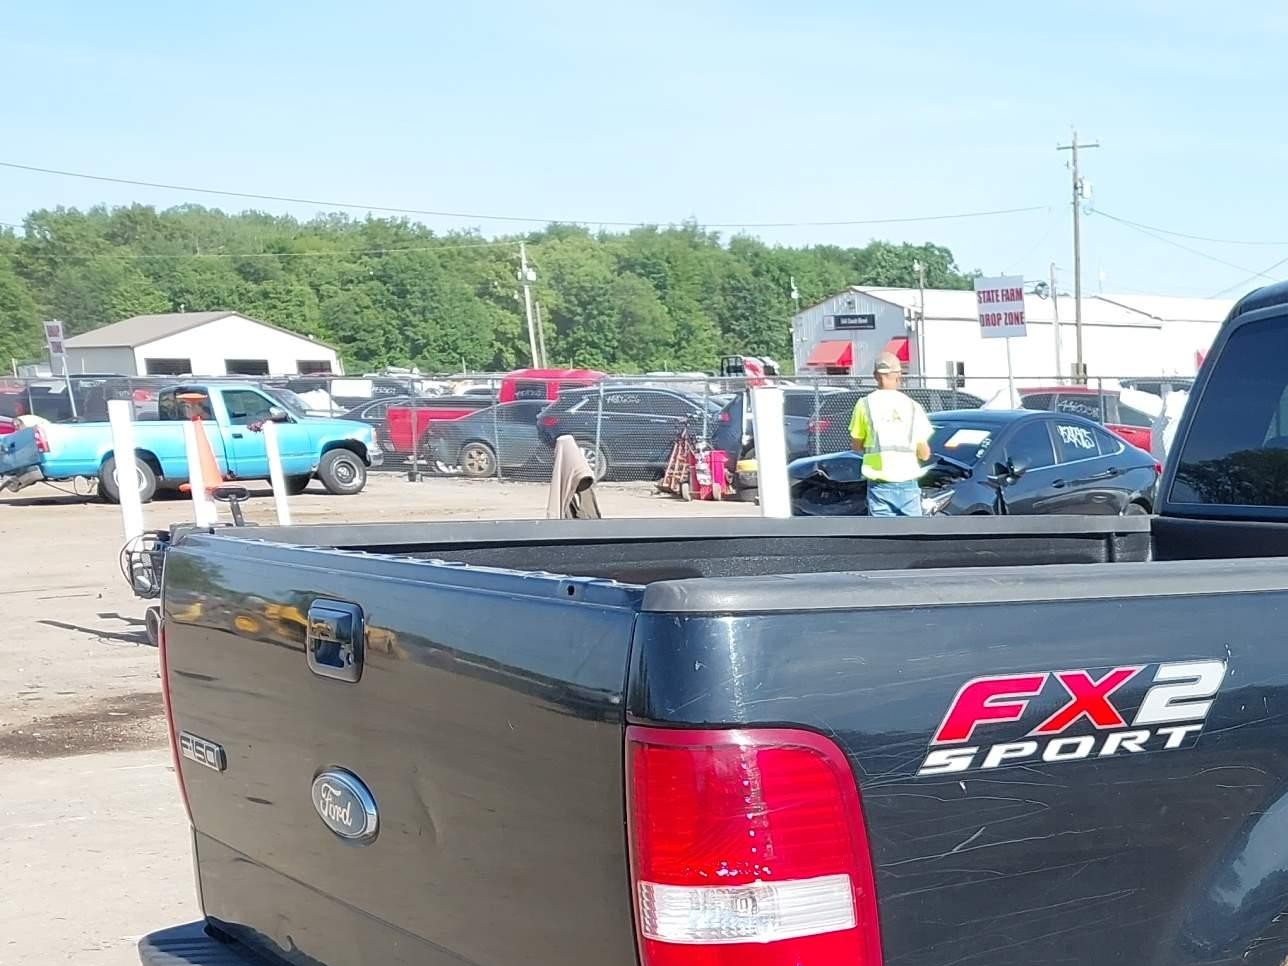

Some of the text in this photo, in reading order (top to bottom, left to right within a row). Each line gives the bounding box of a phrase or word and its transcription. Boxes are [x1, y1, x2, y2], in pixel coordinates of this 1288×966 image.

[976, 287, 1023, 304] STATE FARM
[979, 311, 1025, 327] DROP ZONE
[930, 659, 1227, 745] FX2
[916, 723, 1203, 776] SPORT
[320, 782, 353, 826] Ford
